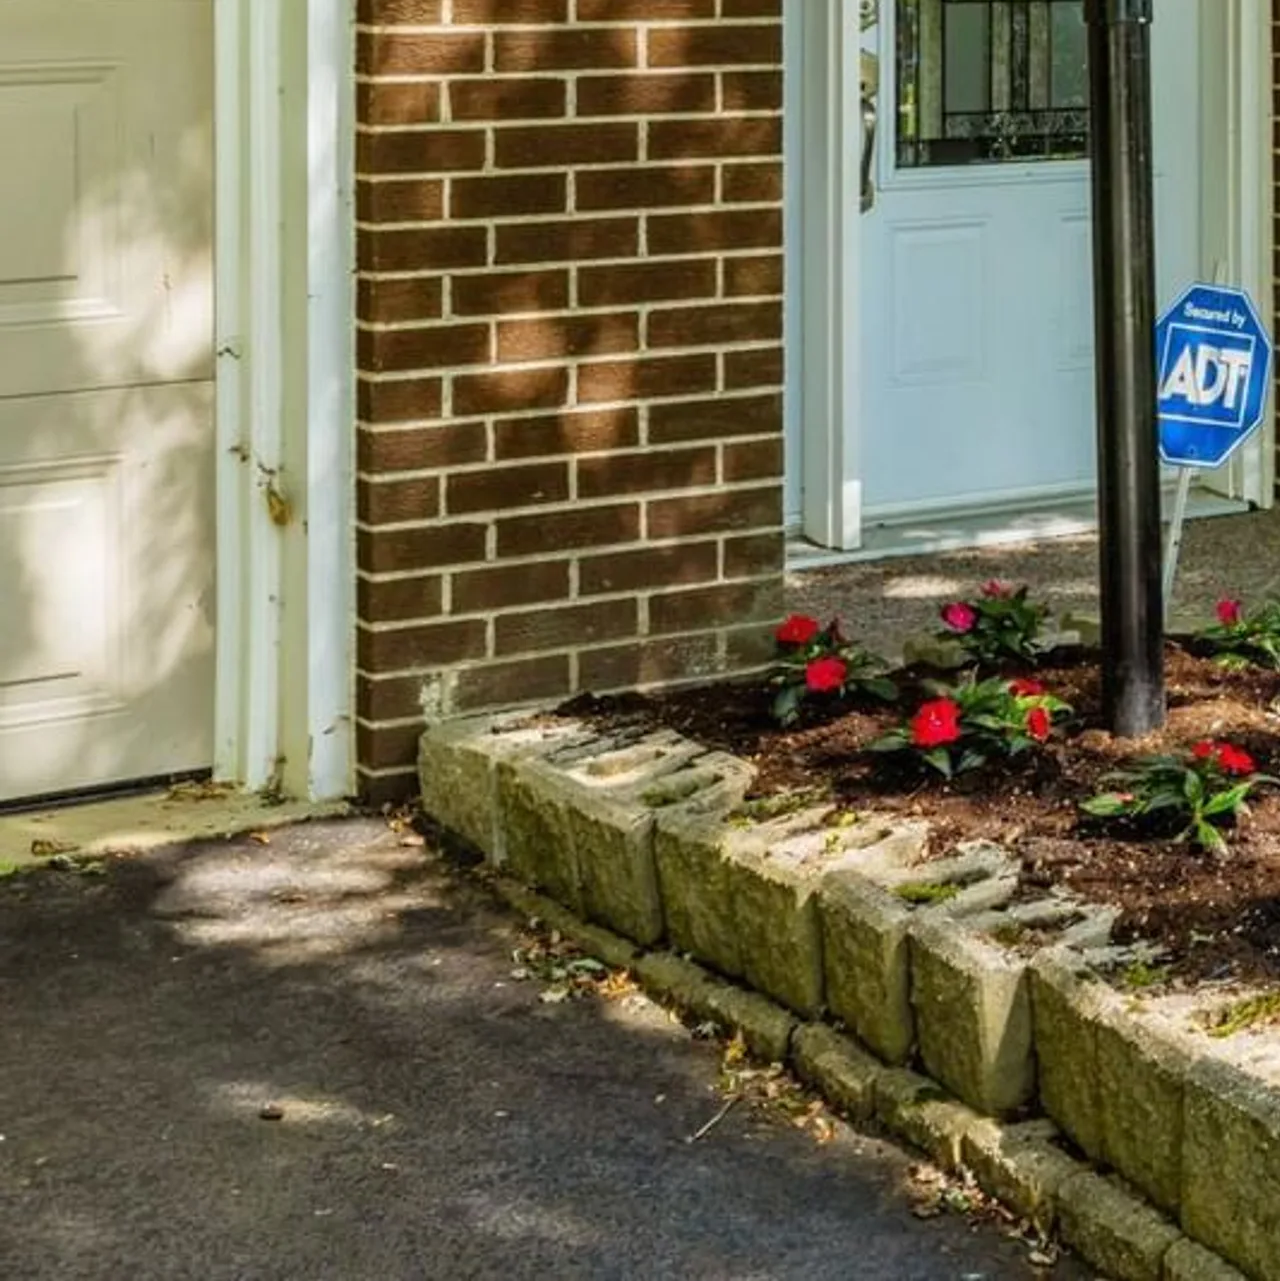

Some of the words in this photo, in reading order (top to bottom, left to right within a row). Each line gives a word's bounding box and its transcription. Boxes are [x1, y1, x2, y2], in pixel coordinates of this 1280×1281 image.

[1184, 301, 1230, 322] Secured
[1232, 308, 1246, 329] by
[1159, 342, 1250, 409] ADT
